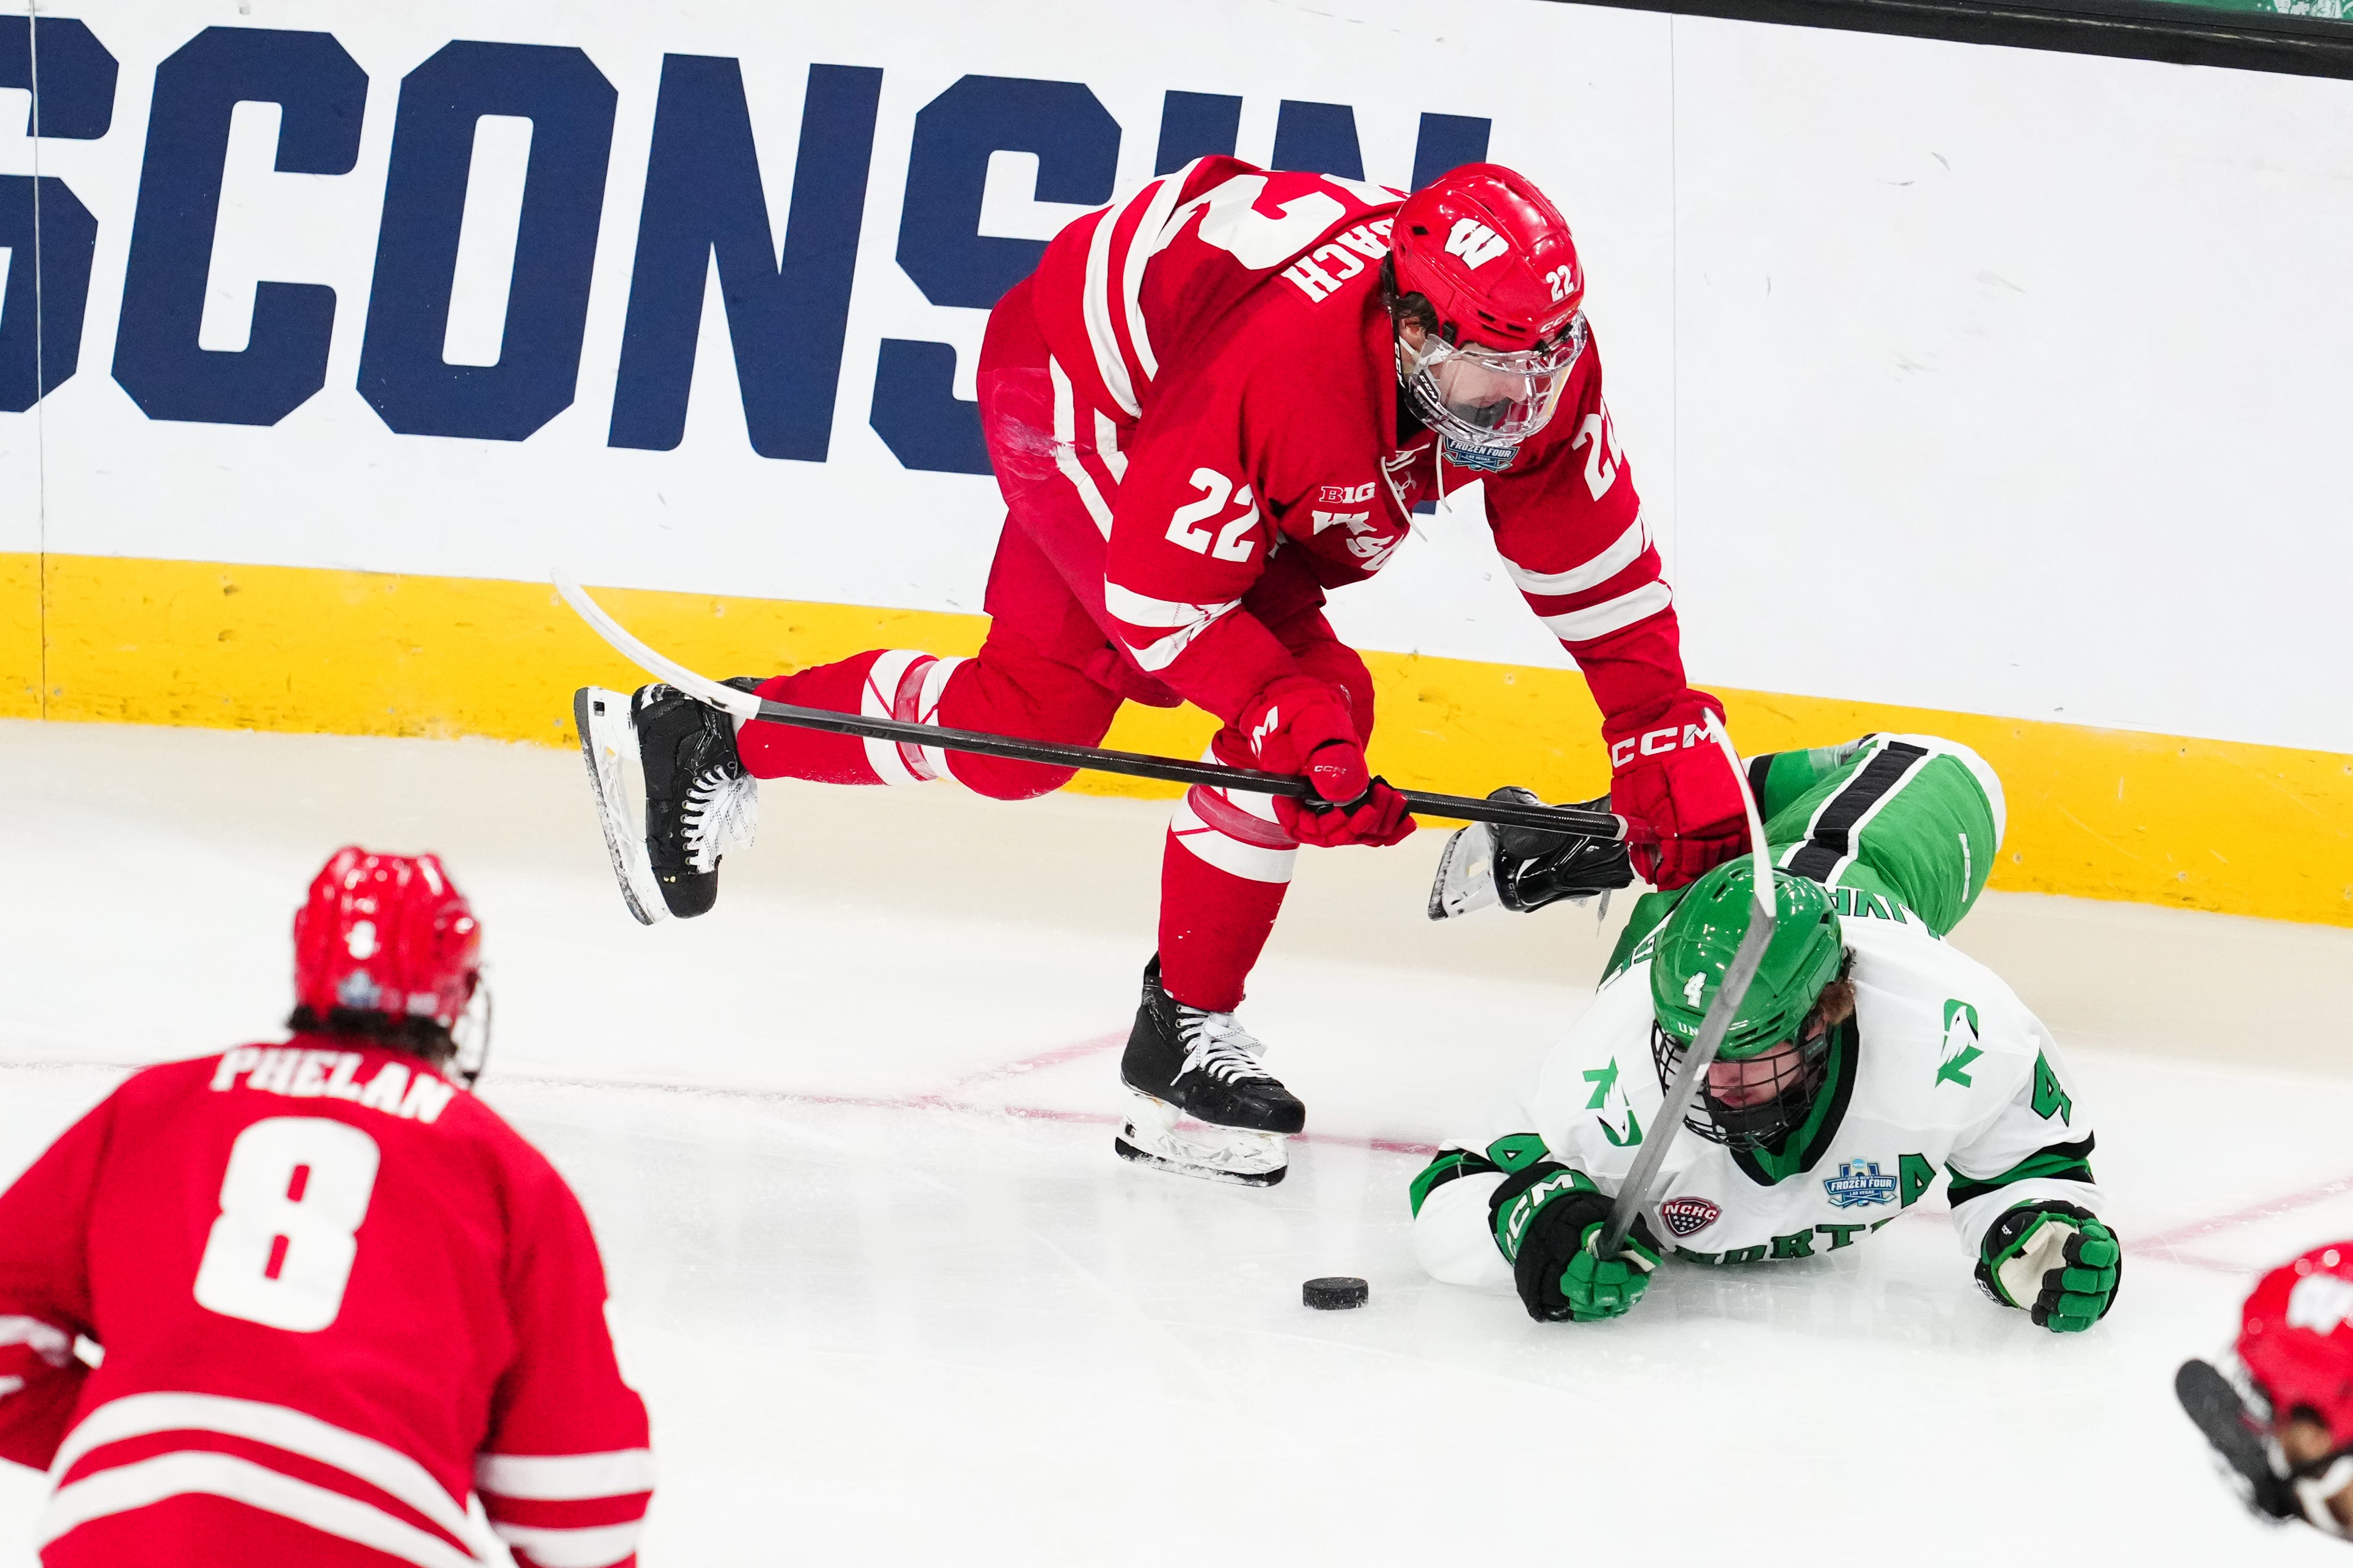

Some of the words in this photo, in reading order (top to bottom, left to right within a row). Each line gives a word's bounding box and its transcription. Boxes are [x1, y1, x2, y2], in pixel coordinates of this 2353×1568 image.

[0, 14, 1492, 515] CONS
[1545, 265, 1574, 302] 22
[1419, 375, 1438, 399] CCM
[1450, 440, 1485, 454] FROZEN
[1487, 447, 1512, 458] FOUR
[1165, 467, 1259, 562] 22
[1612, 724, 1719, 768] CCM
[1683, 970, 1708, 1008] 4
[1677, 1021, 1699, 1036] UN
[211, 1046, 458, 1124] PHELAN
[1831, 1179, 1866, 1191] FROZEN
[1868, 1179, 1892, 1188] FOUR
[1898, 1153, 1936, 1209] A
[193, 1116, 381, 1333] 8
[1664, 1203, 1718, 1221] NCHC
[1673, 1216, 1895, 1264] NORT
